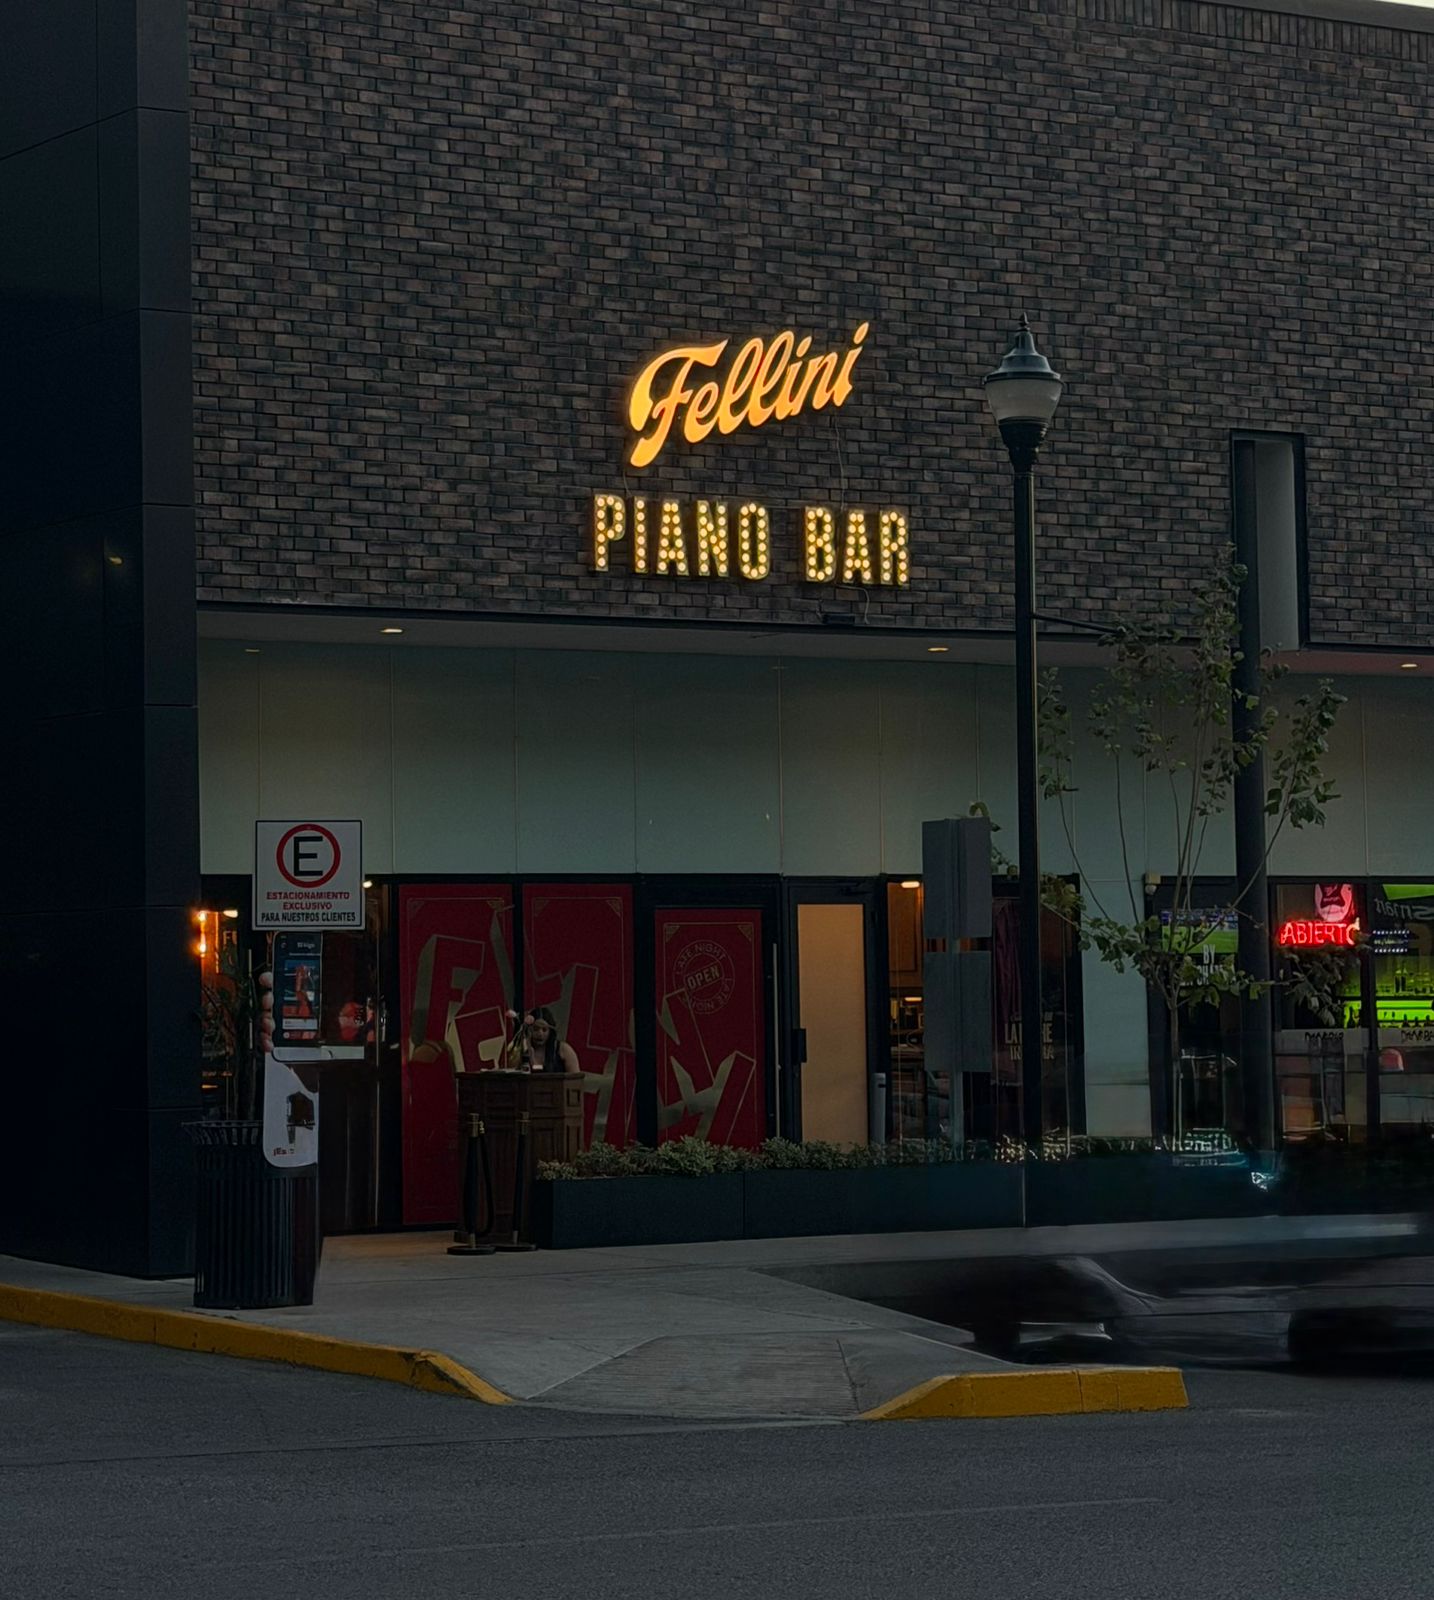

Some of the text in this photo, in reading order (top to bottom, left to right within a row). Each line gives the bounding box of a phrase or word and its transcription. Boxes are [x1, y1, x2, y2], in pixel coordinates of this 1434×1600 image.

[629, 321, 870, 468] Fellini
[594, 493, 910, 586] PIANO BAR
[293, 836, 323, 876] E
[266, 891, 350, 900] ESTACIONAMIENTO
[283, 902, 333, 910] EXCLUSIVO
[261, 912, 356, 922] PARA NUESTROS CLIENTES
[1202, 943, 1216, 964] BY
[687, 964, 720, 990] OPEN
